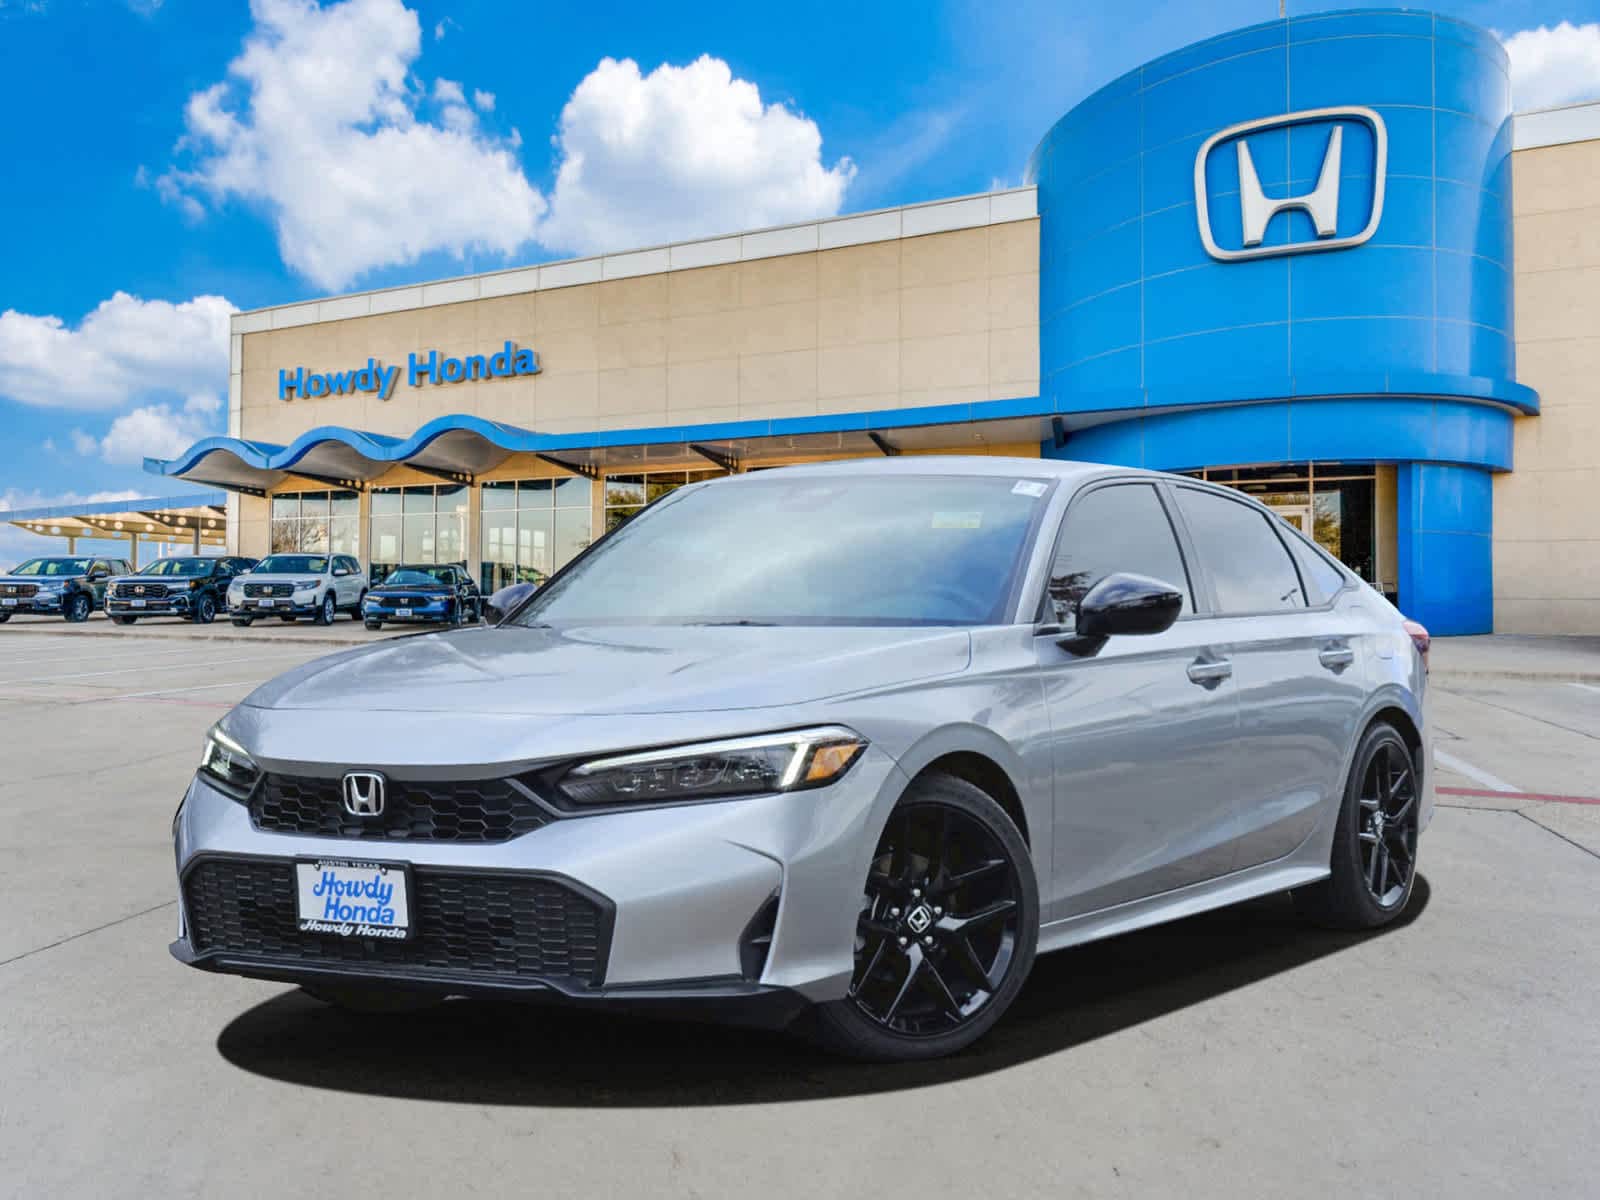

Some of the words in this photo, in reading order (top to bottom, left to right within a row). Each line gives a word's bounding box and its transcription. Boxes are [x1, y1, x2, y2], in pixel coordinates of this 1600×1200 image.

[279, 357, 398, 401] Howdy
[408, 340, 541, 387] Honda
[313, 871, 393, 906] Howdy
[324, 896, 395, 924] Honda
[300, 920, 354, 936] Howdy
[355, 923, 407, 939] Honda
